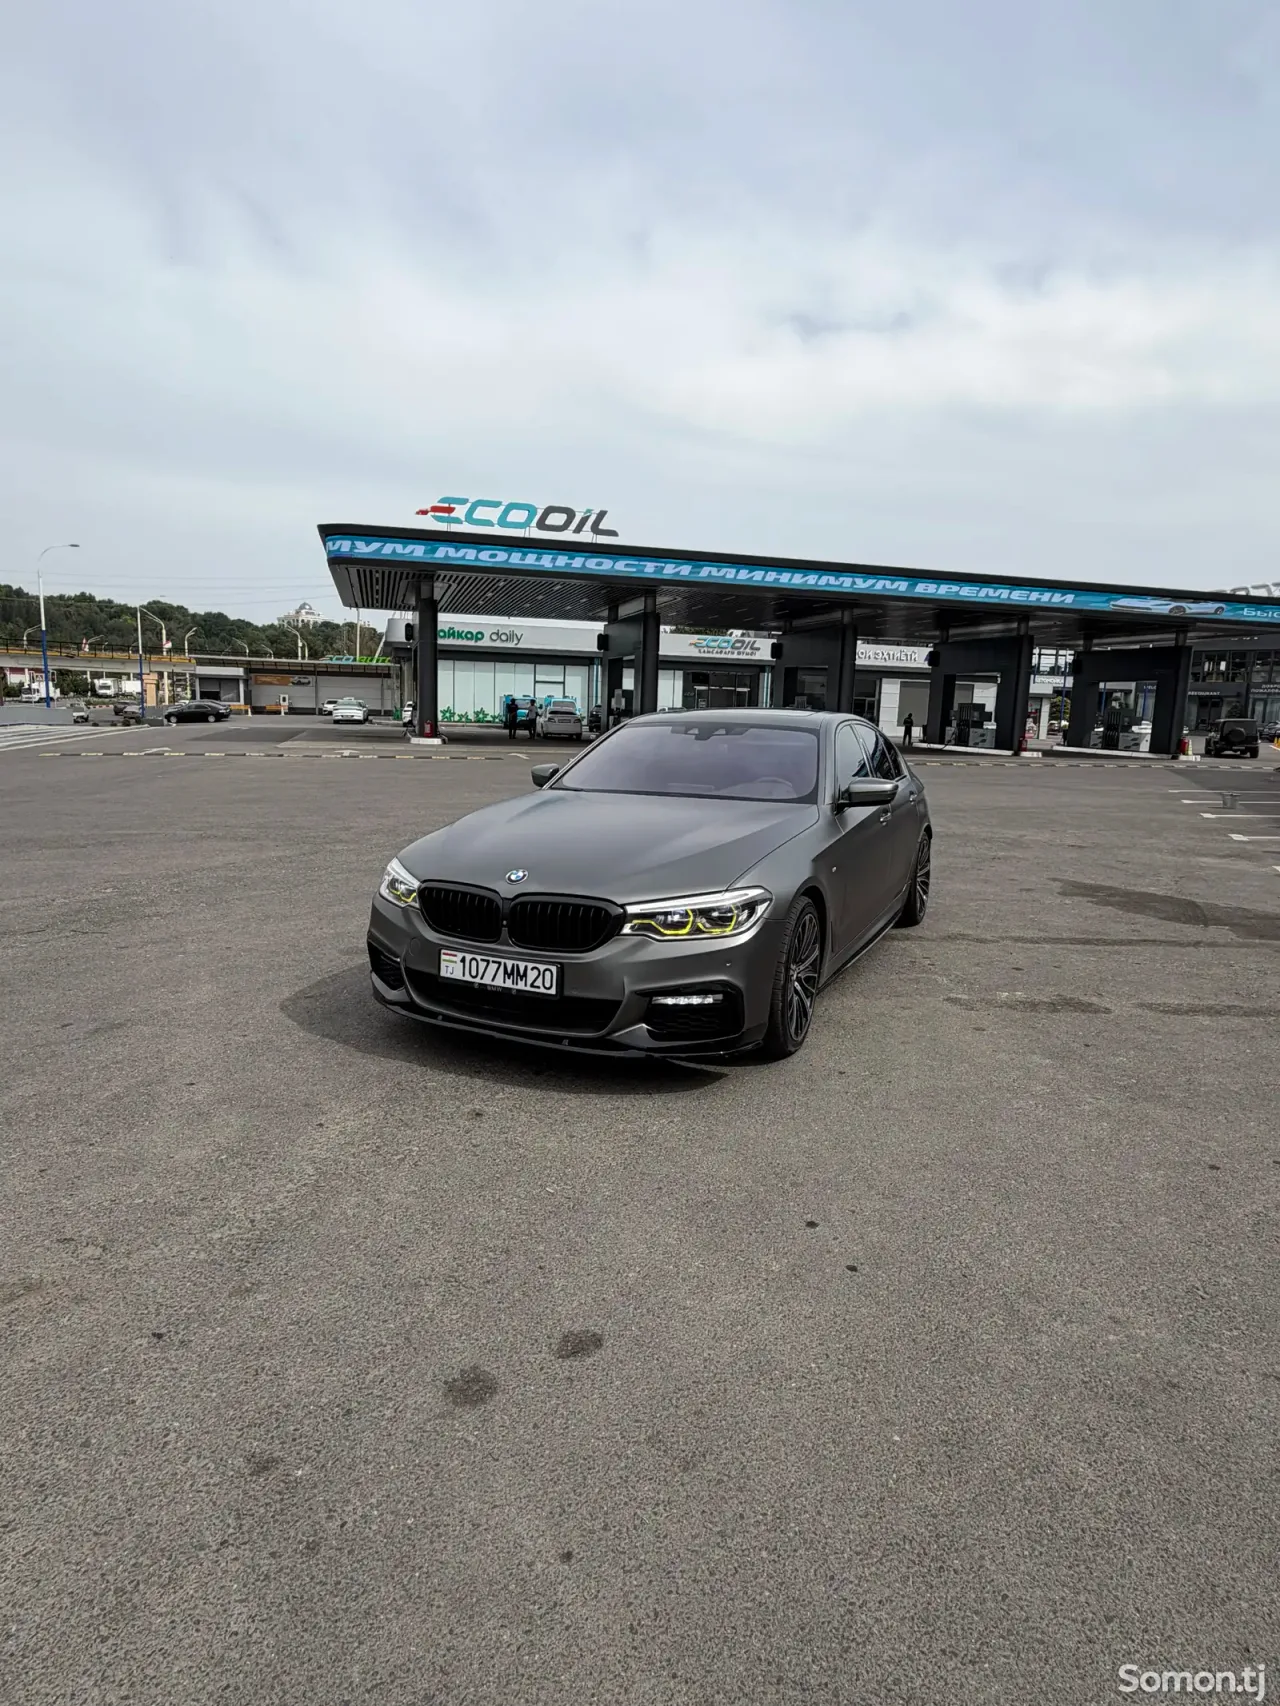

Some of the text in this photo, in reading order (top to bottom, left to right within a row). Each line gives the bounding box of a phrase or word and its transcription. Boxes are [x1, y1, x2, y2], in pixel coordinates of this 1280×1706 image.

[433, 547, 691, 576] МОЩНОСТИ
[699, 566, 907, 592] МИНИМУМ
[914, 582, 1075, 604] ВРЕМЕНИ
[489, 629, 523, 646] daily
[444, 955, 554, 991] TJ 1077MM20
